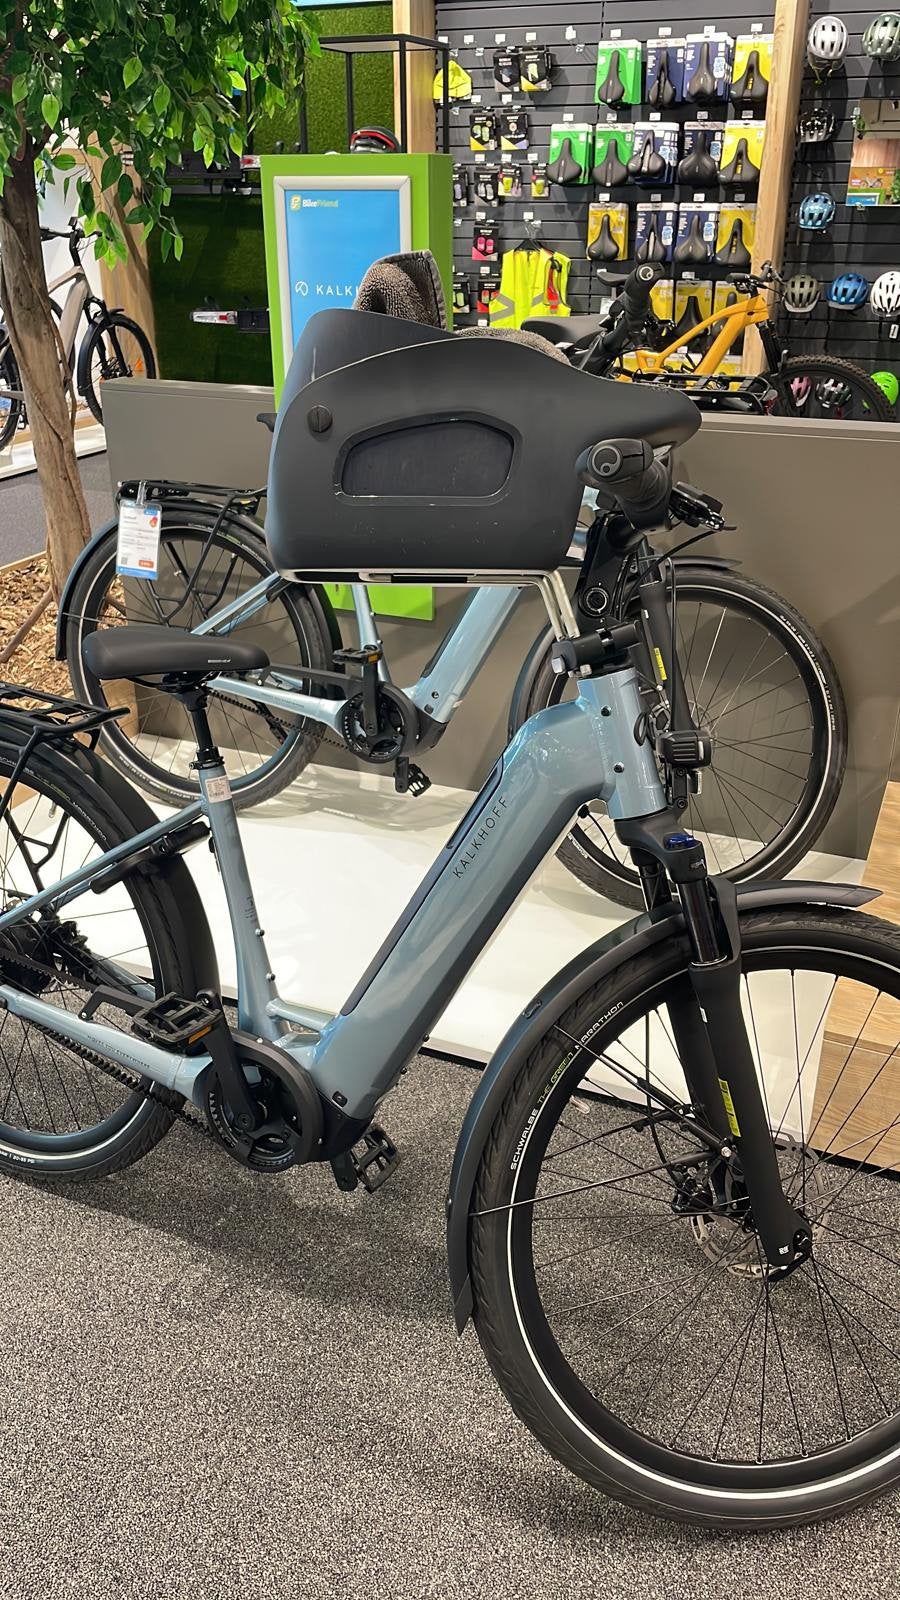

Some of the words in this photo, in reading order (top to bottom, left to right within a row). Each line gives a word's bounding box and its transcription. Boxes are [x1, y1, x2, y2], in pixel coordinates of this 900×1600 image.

[316, 284, 359, 297] KALK
[453, 796, 508, 878] KALKHOFF
[511, 1108, 539, 1171] SCHWALBE
[550, 1052, 574, 1084] GREEN
[575, 1001, 624, 1050] MARATHON
